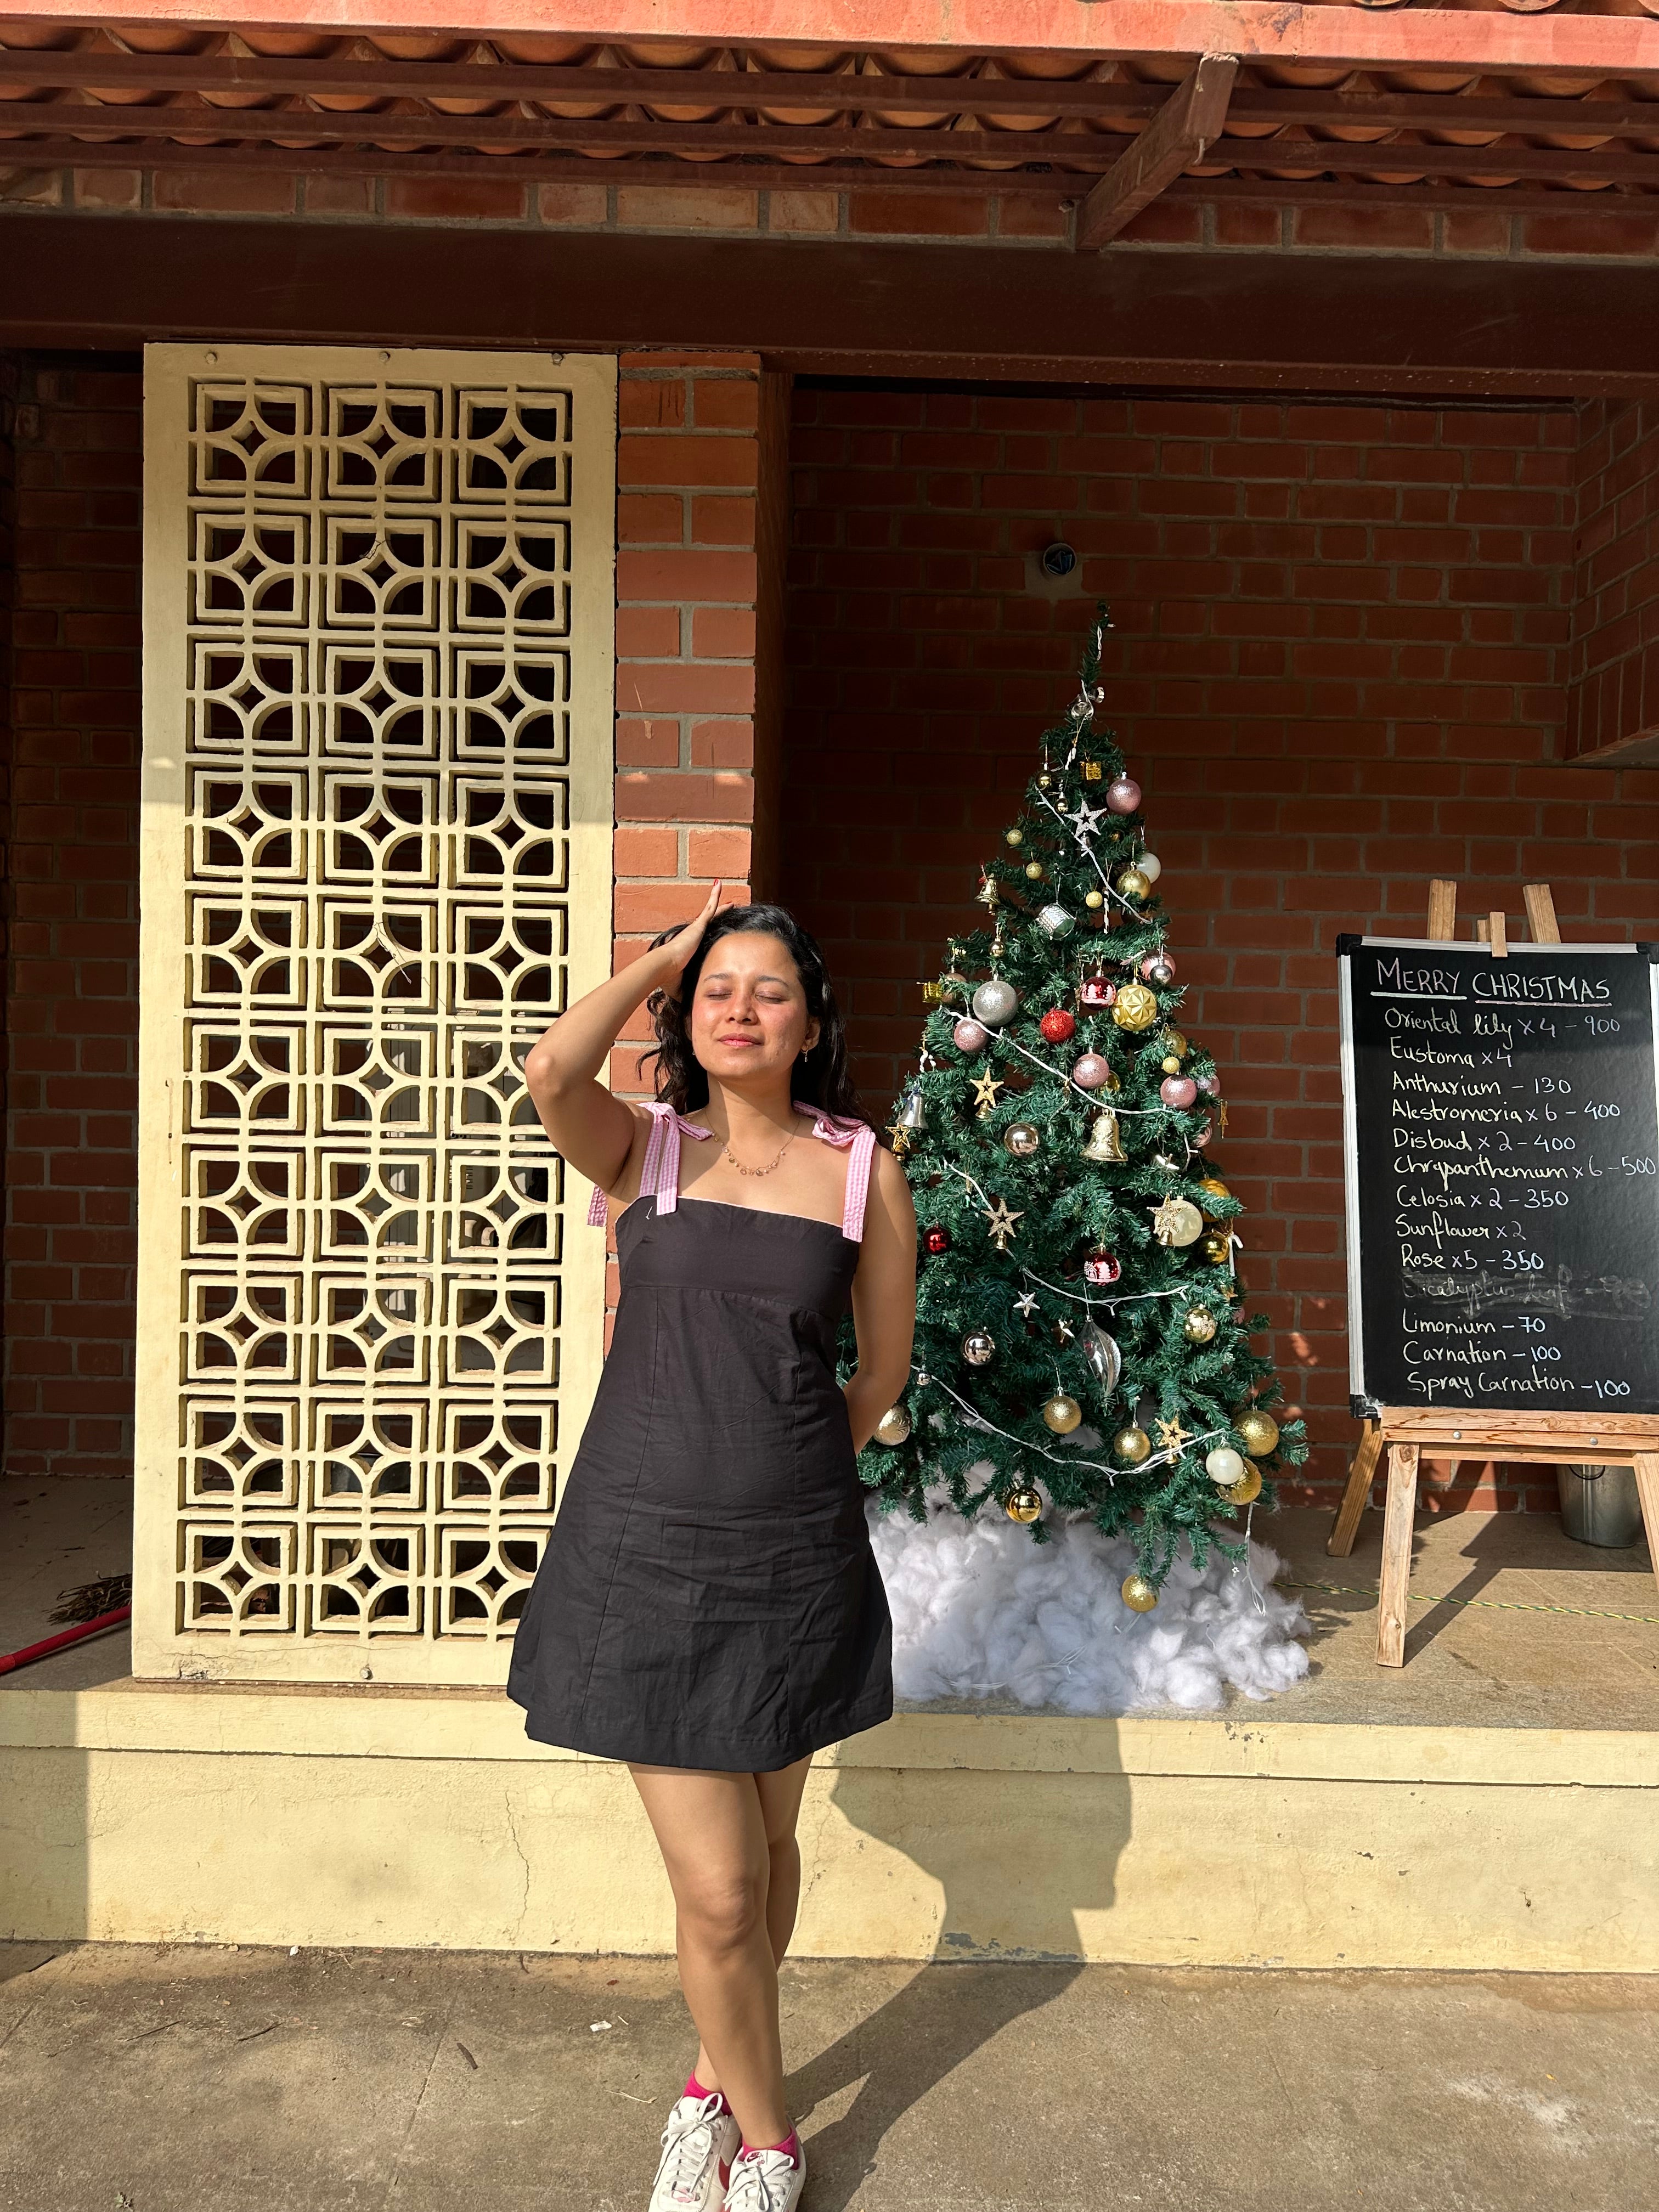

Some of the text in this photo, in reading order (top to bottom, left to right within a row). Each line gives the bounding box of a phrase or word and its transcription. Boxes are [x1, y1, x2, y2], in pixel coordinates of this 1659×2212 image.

[1377, 957, 1611, 1002] MERRY CHRISTMAS
[1385, 1007, 1462, 1035] Oriental
[1473, 1013, 1513, 1050] lily
[1390, 1036, 1475, 1068] Eustoma
[1393, 1070, 1501, 1096] Anthurium
[1536, 1077, 1571, 1094] 130
[1584, 1101, 1621, 1120] 400
[1393, 1127, 1472, 1152] Disbud
[1397, 1184, 1466, 1208] Celosia
[1395, 1210, 1490, 1250] Sunflower
[1401, 1244, 1447, 1269] Rose
[1502, 1249, 1544, 1271] 350
[1403, 1308, 1496, 1334] Limonium
[1403, 1340, 1506, 1364] Carnation
[1407, 1372, 1474, 1401] Spray
[1478, 1364, 1575, 1392] Carnation
